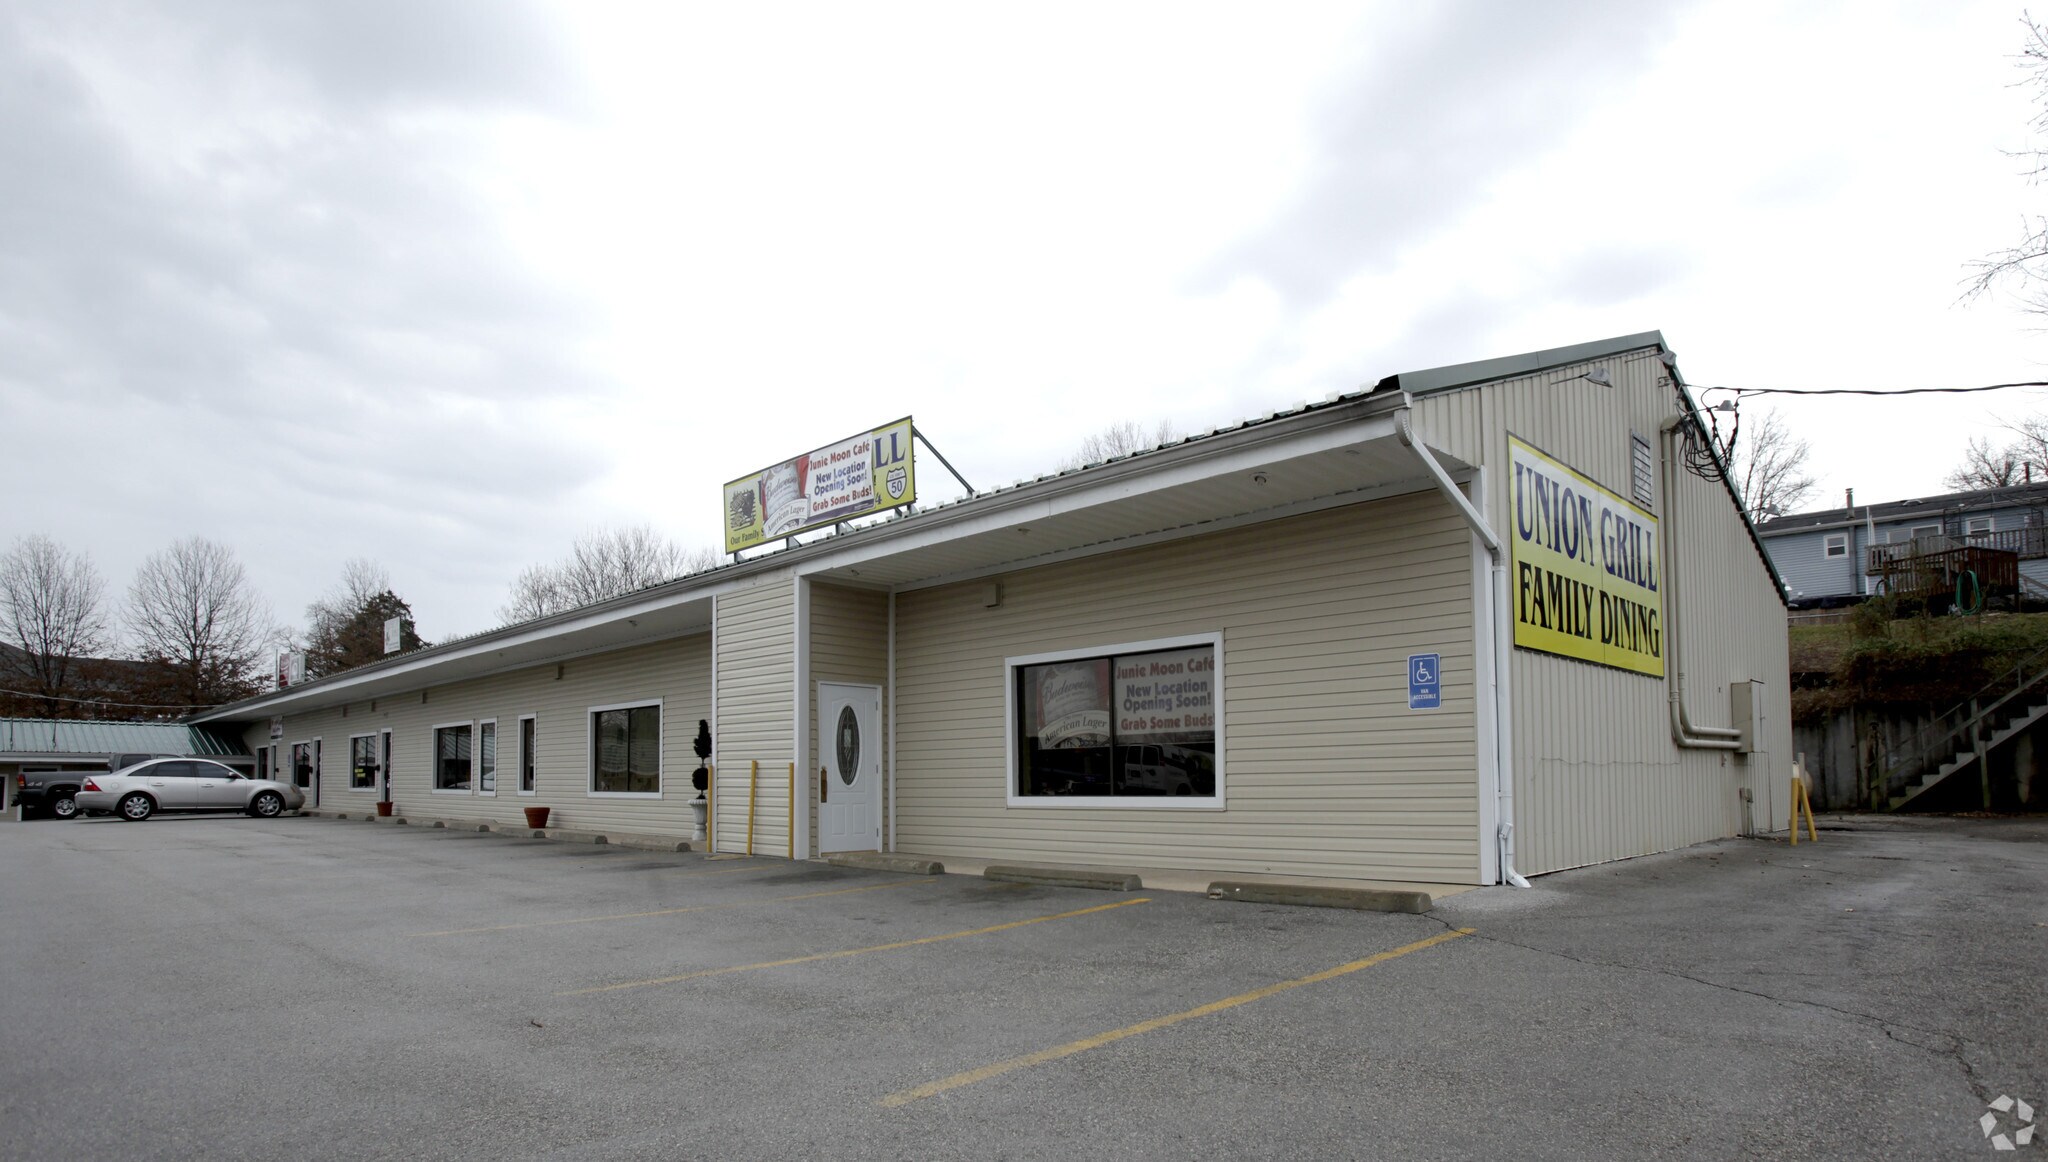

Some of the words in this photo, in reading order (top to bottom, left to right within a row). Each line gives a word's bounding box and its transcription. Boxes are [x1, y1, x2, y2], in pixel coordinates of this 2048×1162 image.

[810, 456, 828, 471] Junie
[830, 449, 851, 464] Moon
[853, 438, 870, 456] Café
[814, 479, 845, 496] Opening
[847, 470, 867, 486] Soon!
[816, 471, 831, 485] New
[834, 461, 866, 479] Location
[812, 498, 829, 512] Grab
[830, 493, 850, 507] Some
[852, 485, 872, 500] Buds!
[891, 480, 903, 494] 50
[731, 536, 741, 545] Our
[742, 529, 759, 542] Family
[1514, 460, 1595, 567] UNION
[1600, 507, 1658, 593] GRILL
[1518, 560, 1595, 640] FAMILY
[1599, 589, 1660, 658] DINING
[1116, 663, 1146, 679] Junie
[1150, 662, 1184, 676] Moon
[1126, 684, 1151, 698] New
[1154, 679, 1208, 696] Location
[1123, 695, 1172, 714] Opening
[1176, 691, 1211, 708] Soon!
[1045, 721, 1080, 744] American
[1082, 716, 1107, 729] Lager
[1121, 717, 1147, 731] Grab
[1150, 716, 1181, 730] Some
